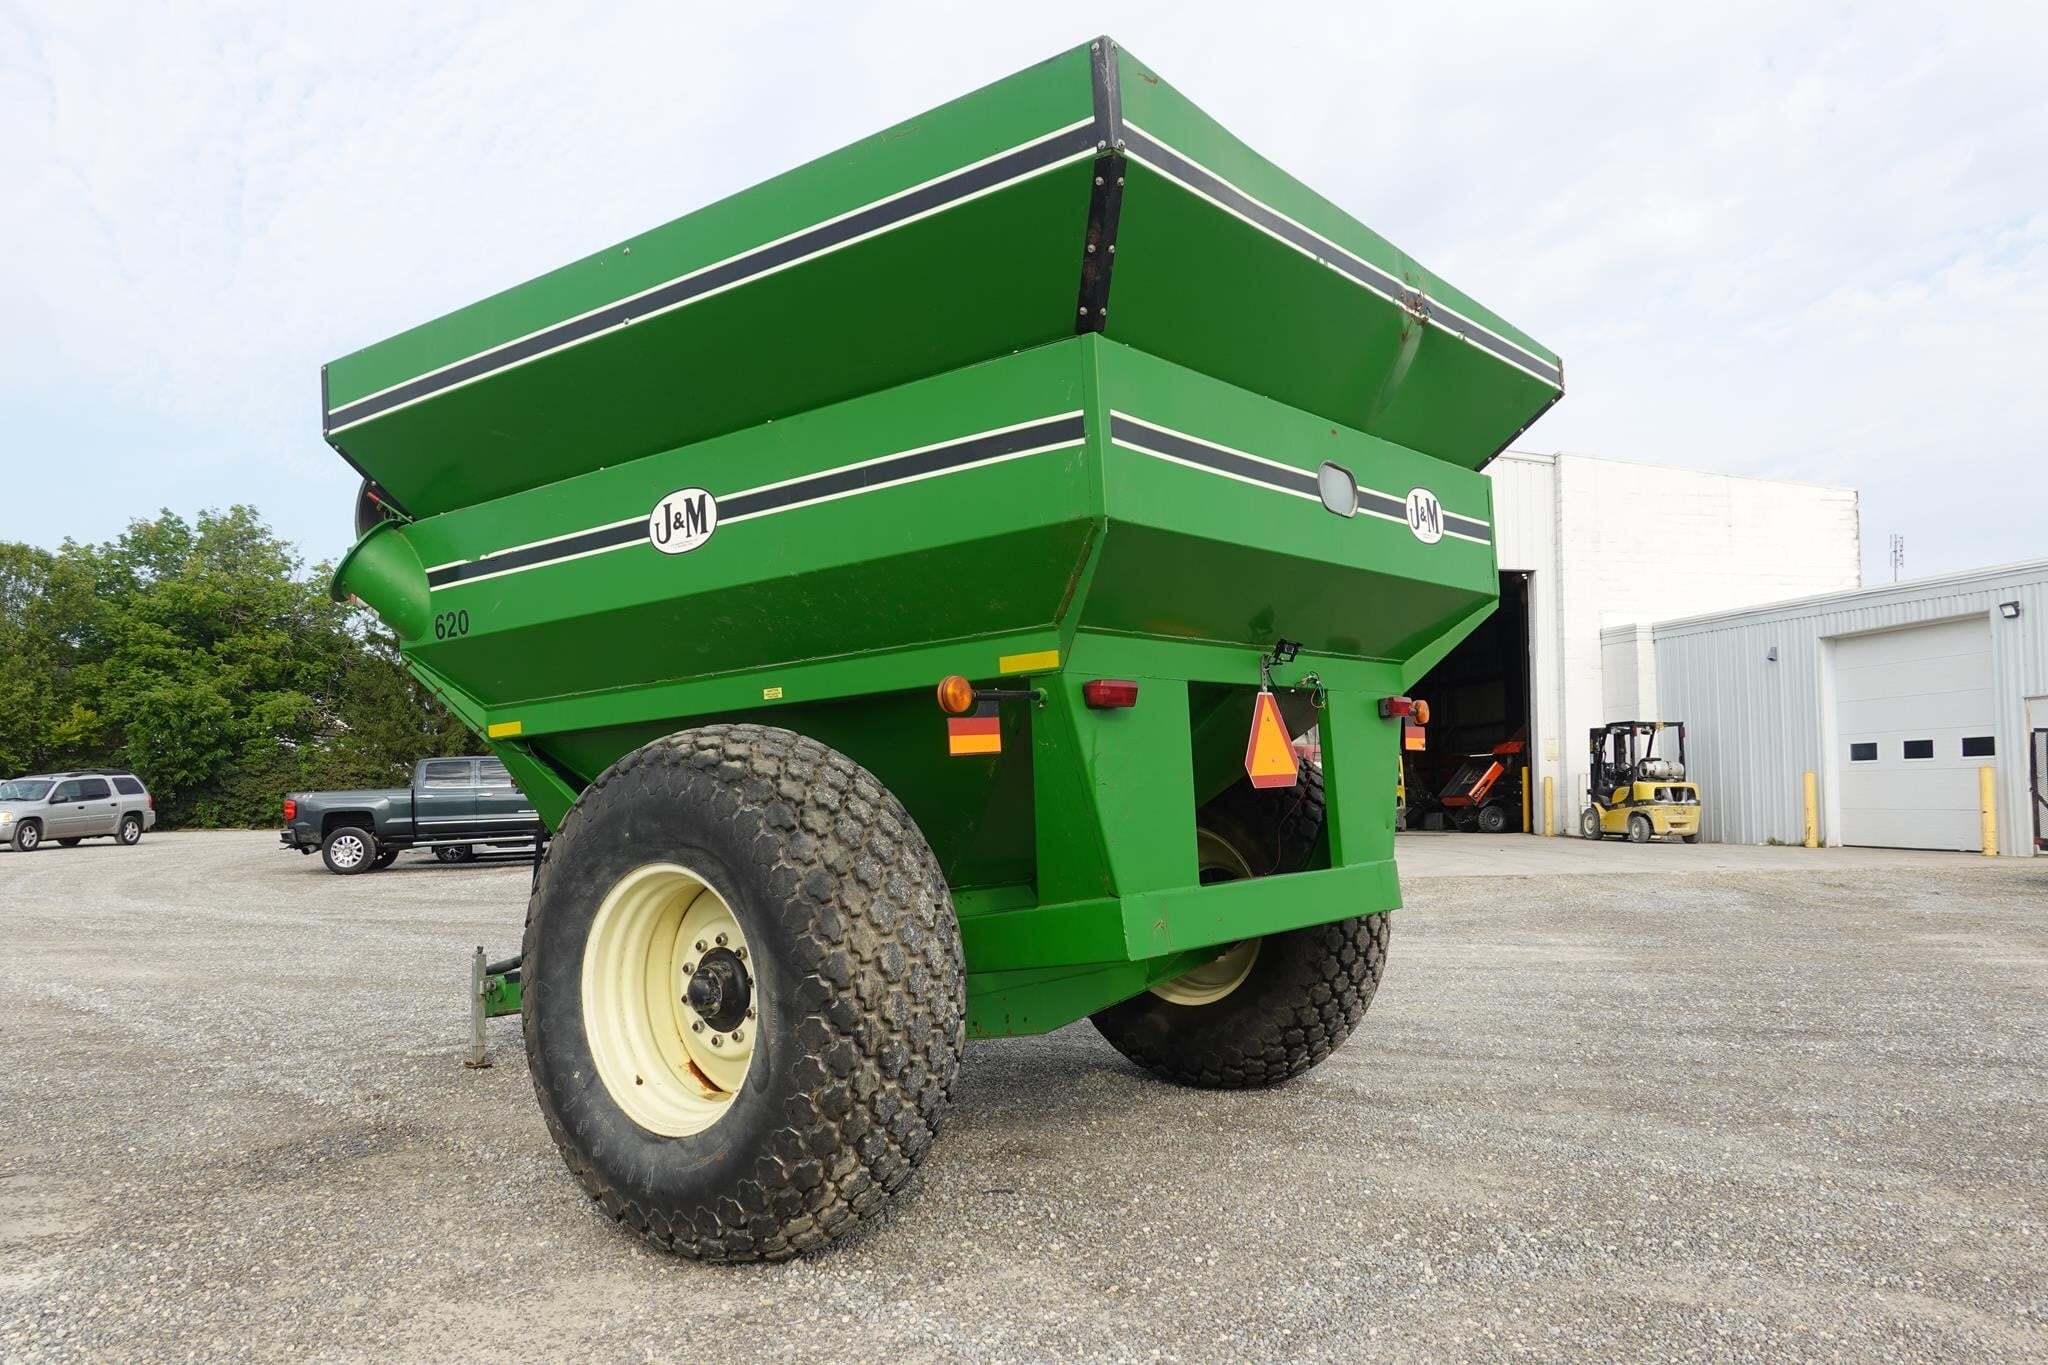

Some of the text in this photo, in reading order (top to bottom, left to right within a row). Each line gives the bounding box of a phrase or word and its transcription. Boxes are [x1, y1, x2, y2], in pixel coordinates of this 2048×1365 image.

[654, 493, 709, 545] J&M
[1410, 495, 1440, 535] J&M
[434, 609, 470, 641] 620
